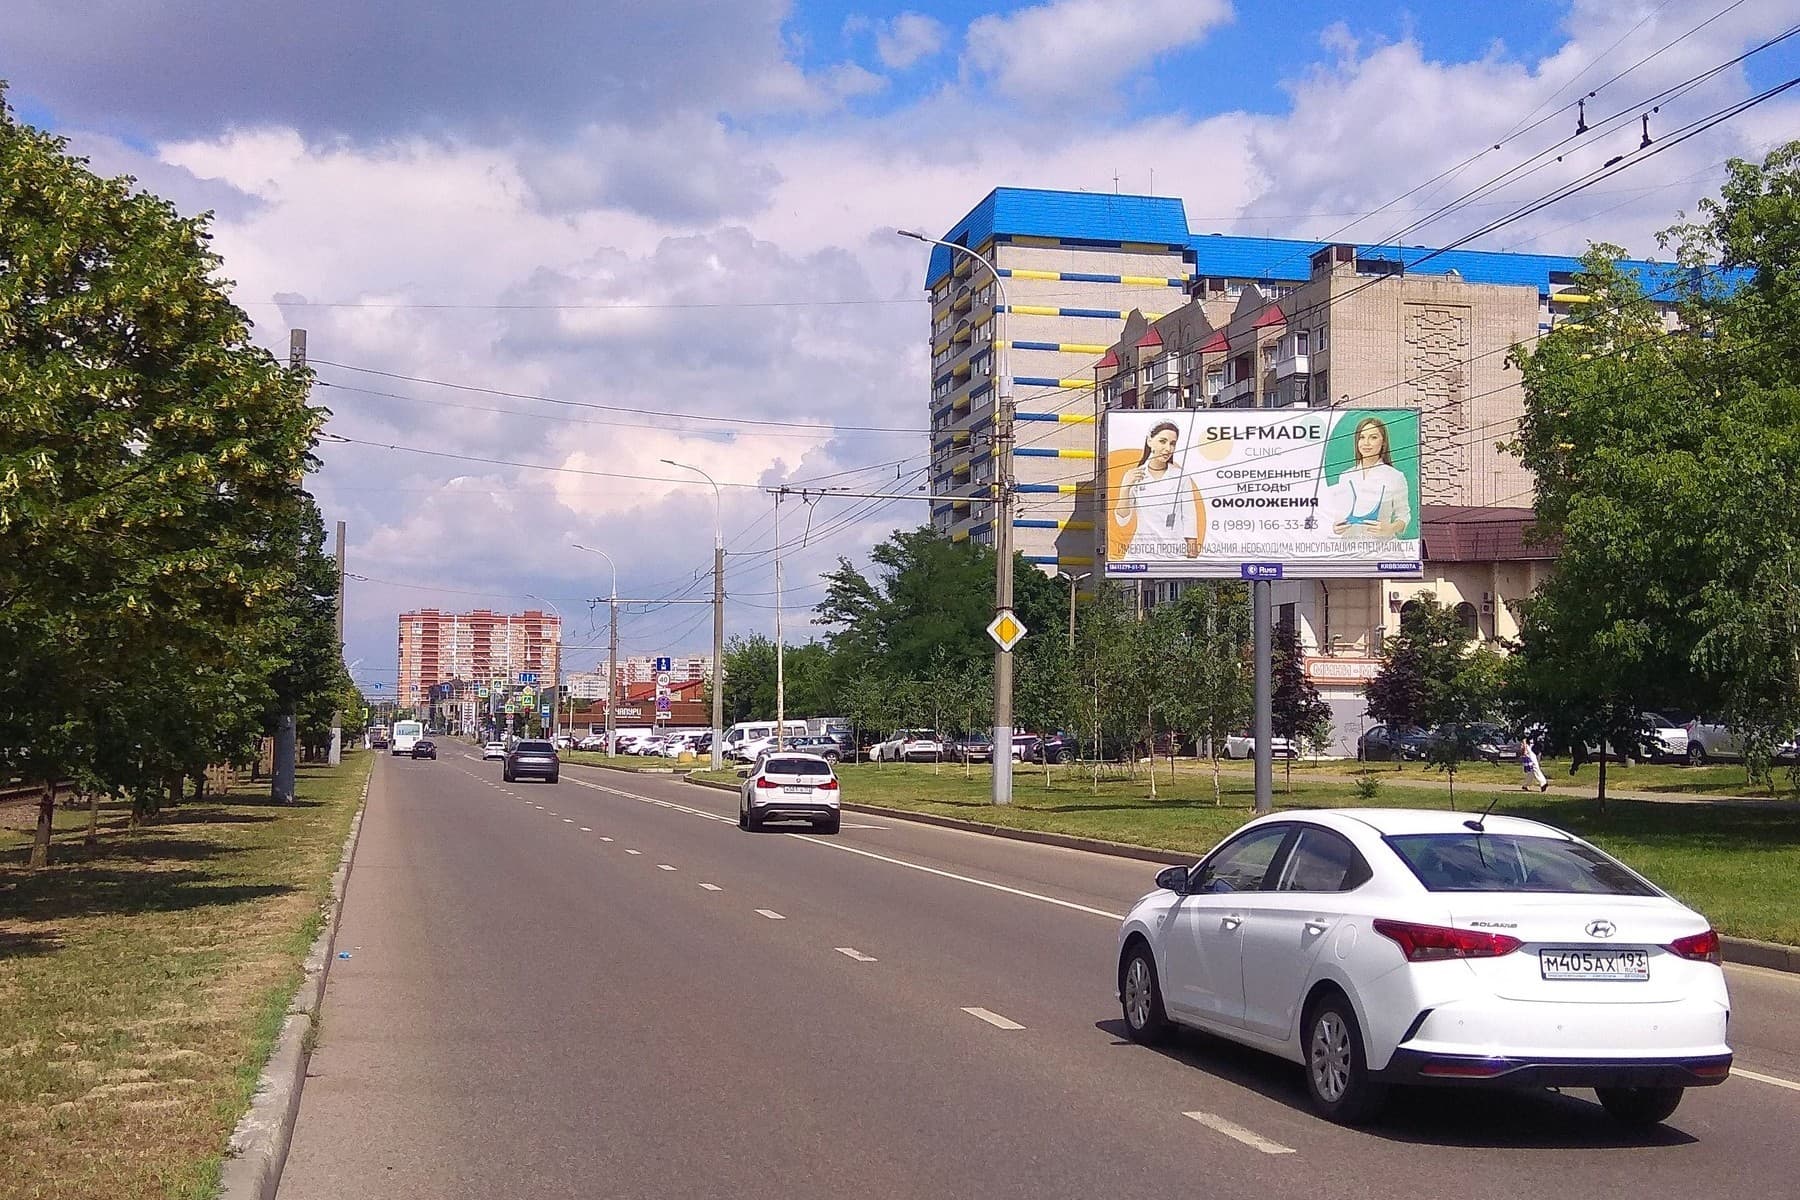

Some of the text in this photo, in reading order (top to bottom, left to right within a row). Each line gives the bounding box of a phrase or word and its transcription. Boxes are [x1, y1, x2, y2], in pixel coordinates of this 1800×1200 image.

[1206, 425, 1321, 440] SELFMADE
[1244, 447, 1283, 457] CLINIC
[1216, 469, 1312, 479] СОВРЕМЕННЫЕ
[1237, 483, 1291, 493] МЕТОДЫ
[1211, 497, 1319, 508] ОМОЛОЖЕНИЯ
[1211, 519, 1319, 532] 8 (989) 166-33-33
[1117, 543, 1155, 554] ИМЕЮТСЯ
[1241, 542, 1294, 553] НЕОБХОДИМА
[1295, 541, 1356, 553] КОНСУЛЬТАЦИЯ
[1619, 952, 1643, 967] 193
